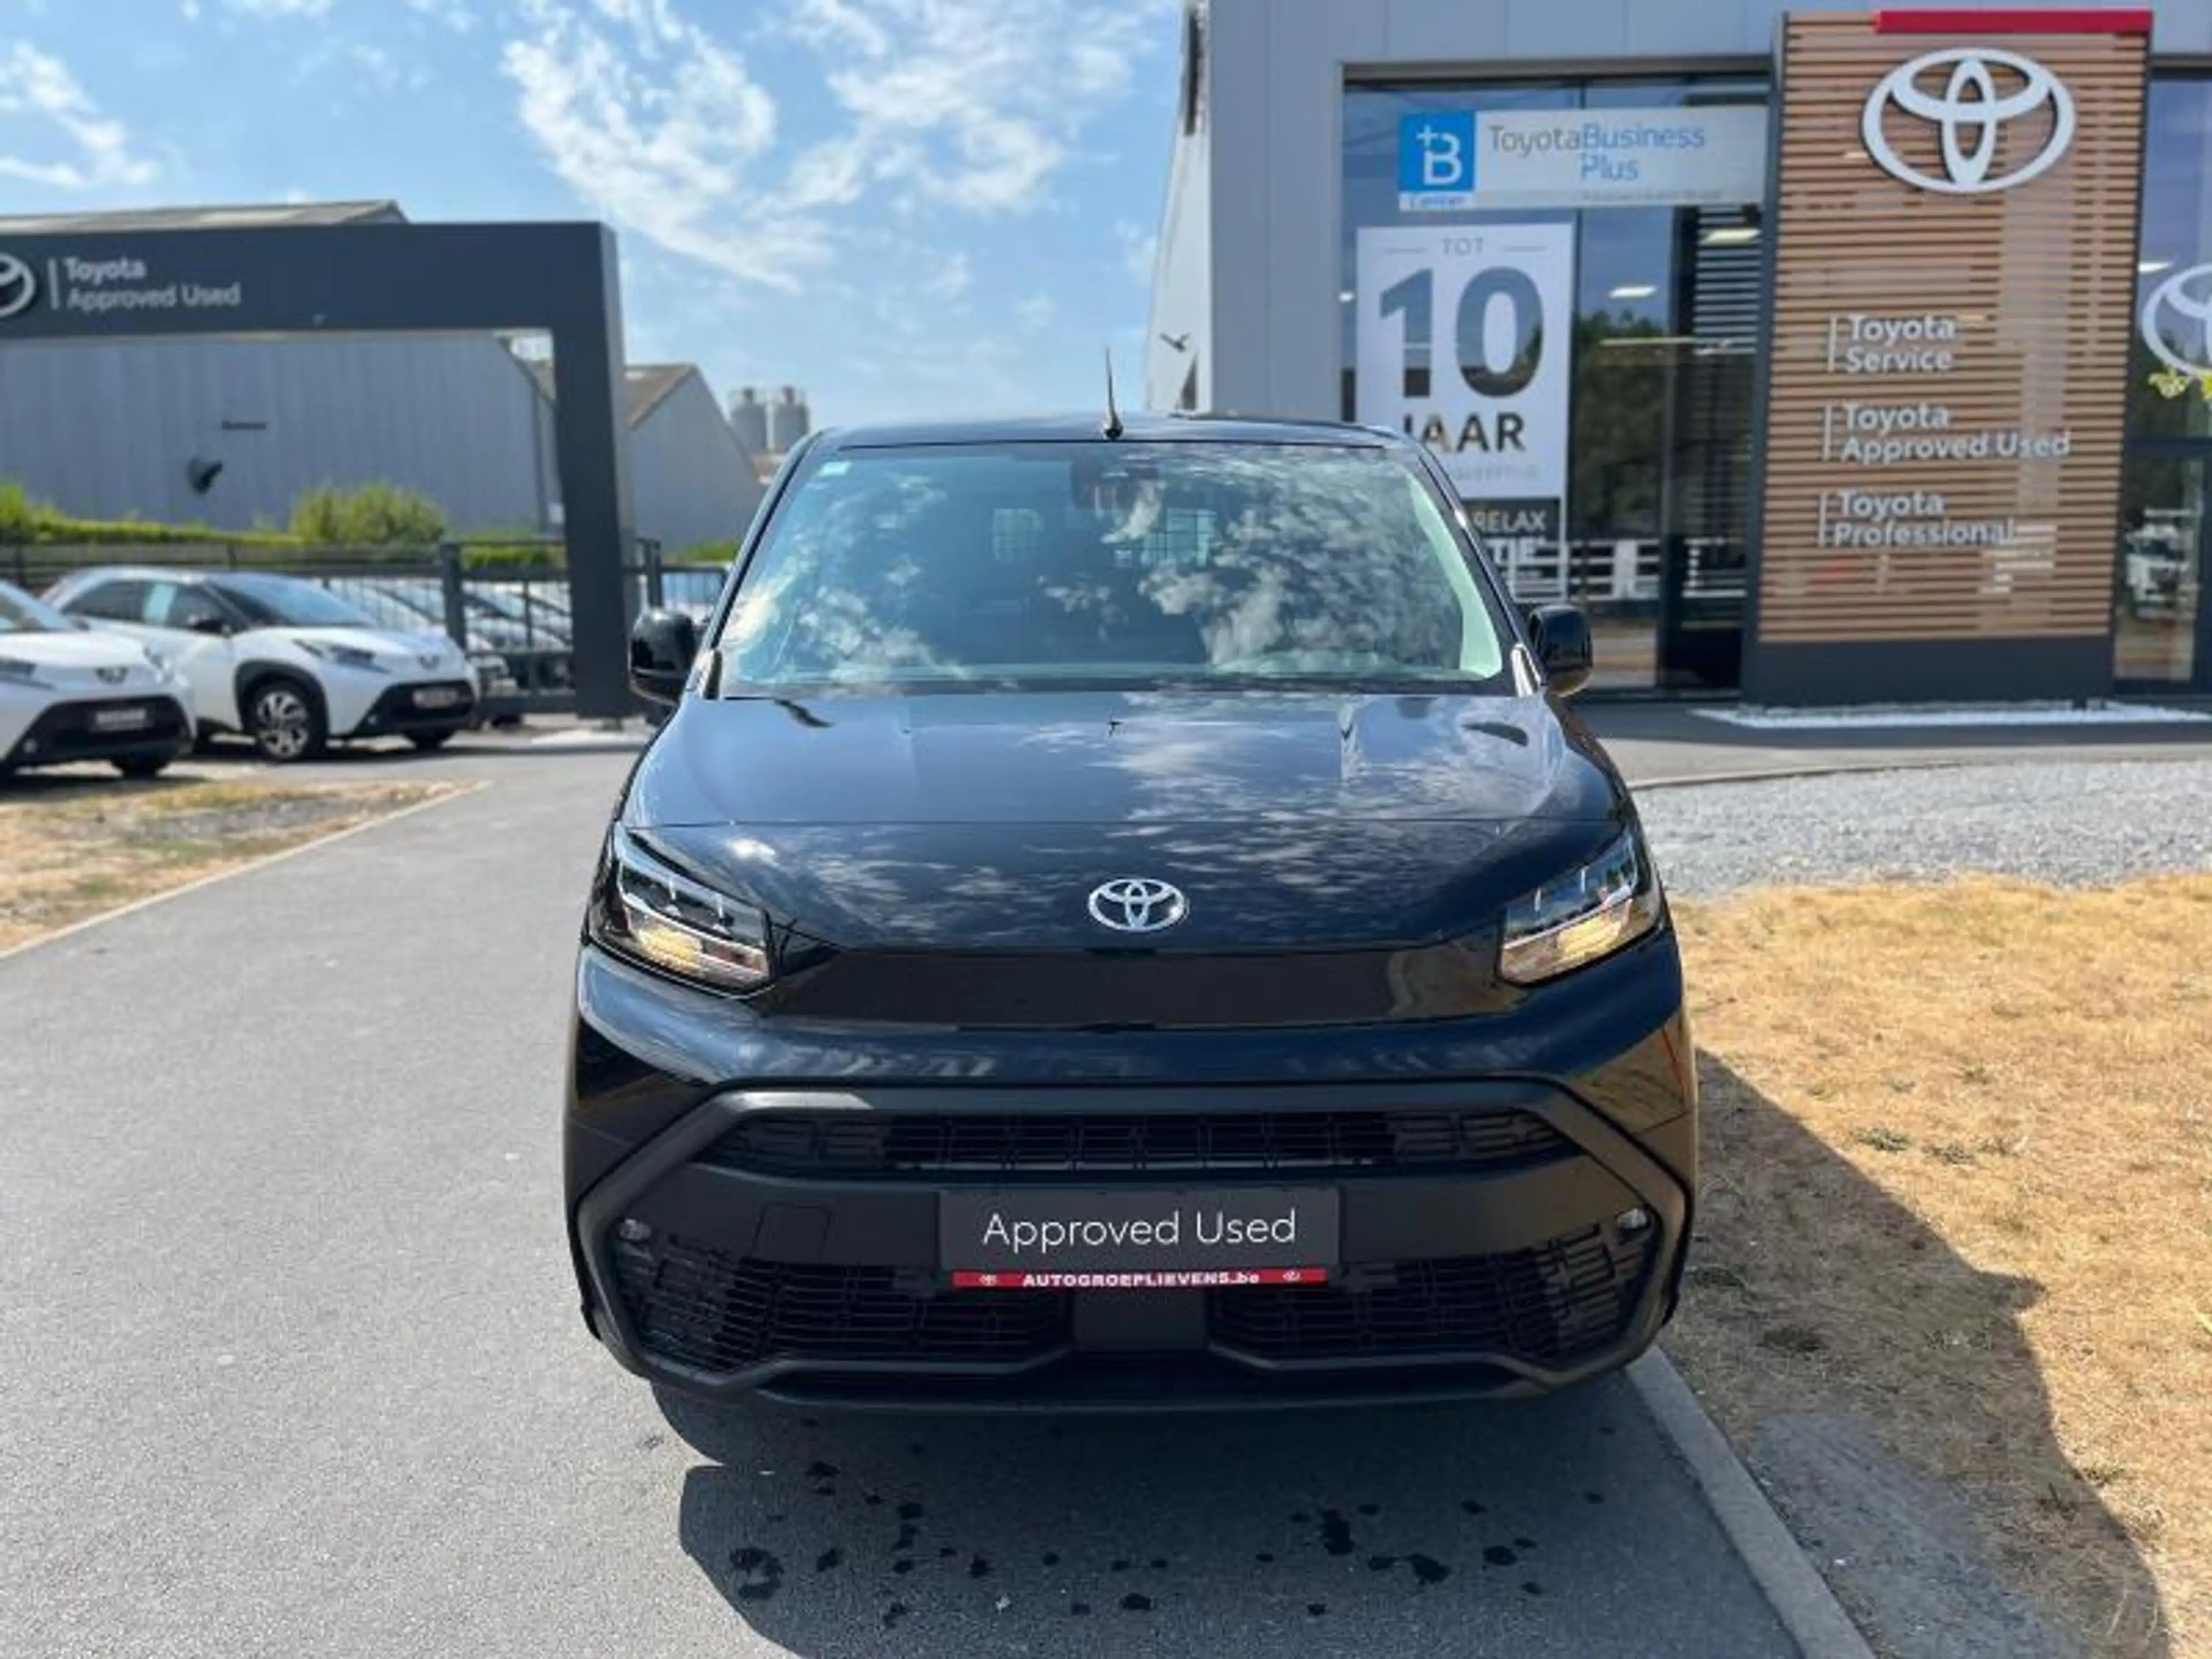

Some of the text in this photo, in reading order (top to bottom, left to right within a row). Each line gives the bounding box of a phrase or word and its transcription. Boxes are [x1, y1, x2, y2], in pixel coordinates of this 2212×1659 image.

[1579, 152, 1638, 180] Plus
[1442, 237, 1484, 256] TOT
[63, 257, 148, 285] Toyota
[66, 282, 242, 315] Approved Used
[1379, 266, 1544, 398] 10
[1847, 314, 1957, 347] Toyota
[1844, 347, 1953, 373] Service
[1844, 403, 1950, 435] Toyota
[1842, 430, 2071, 464] Approved Used
[1838, 488, 1946, 520] Toyota
[1833, 517, 2015, 547] Professional
[982, 1208, 1297, 1253] Approved Used
[1021, 1271, 1260, 1288] AUTOGROEPLIEVENS.be
